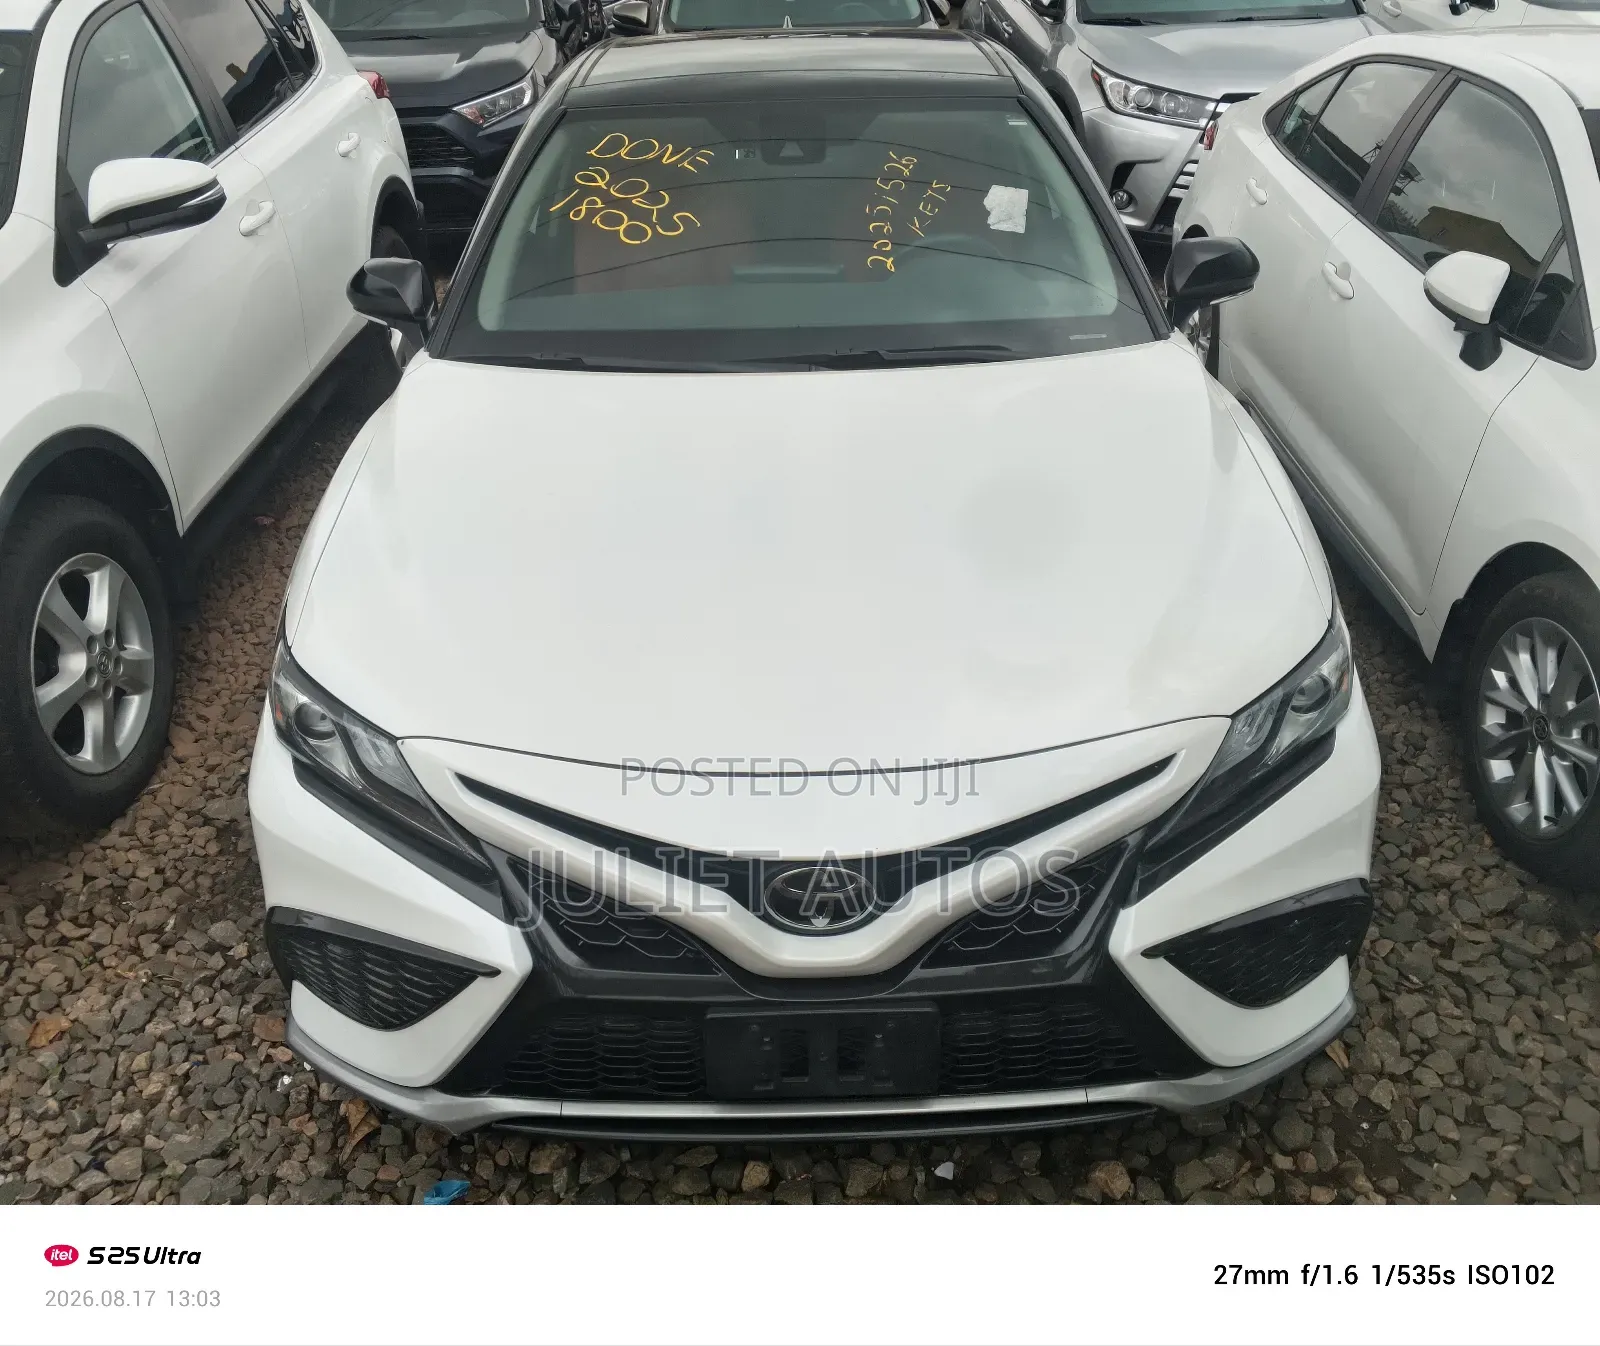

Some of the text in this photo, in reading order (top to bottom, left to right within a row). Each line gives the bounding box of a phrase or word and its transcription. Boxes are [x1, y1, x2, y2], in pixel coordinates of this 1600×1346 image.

[586, 132, 715, 173] DONE
[549, 188, 652, 245] 1800
[574, 166, 701, 236] 2025
